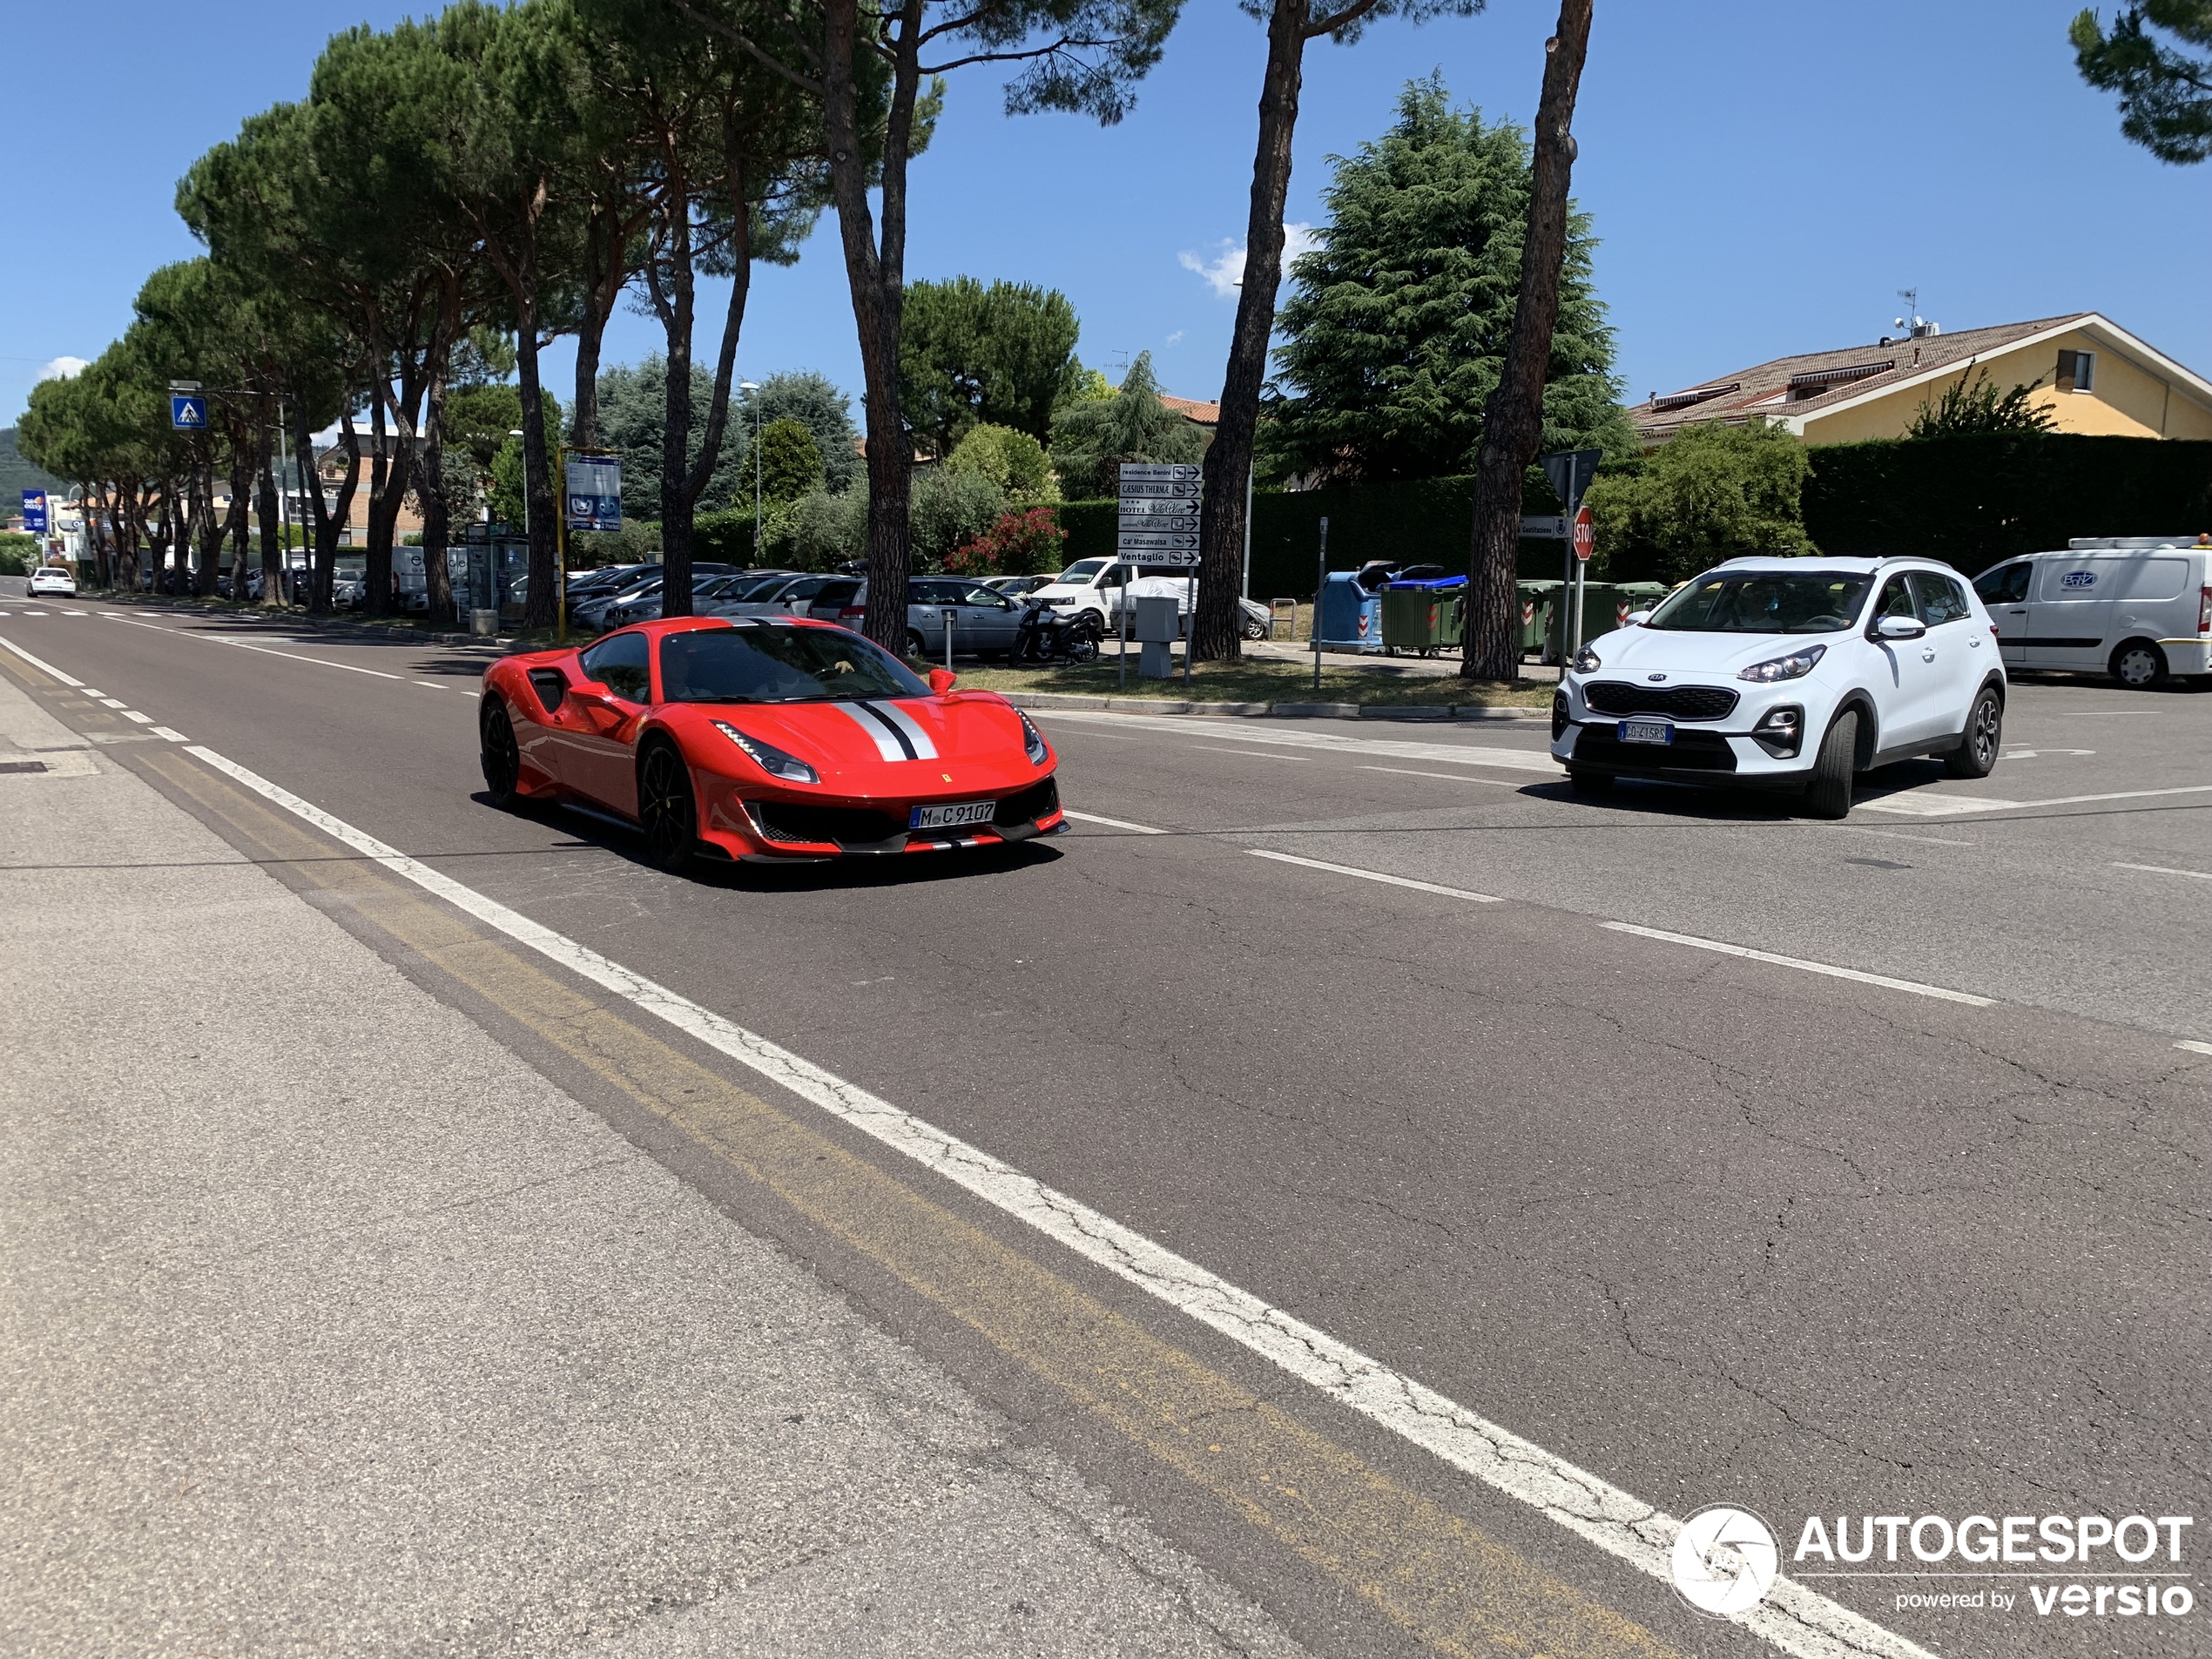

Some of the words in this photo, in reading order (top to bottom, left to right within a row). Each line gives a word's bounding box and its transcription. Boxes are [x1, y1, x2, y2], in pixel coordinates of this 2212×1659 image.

[1522, 525, 1552, 534] Costituzione
[1121, 552, 1164, 562] Ventaglio
[921, 809, 933, 825] M
